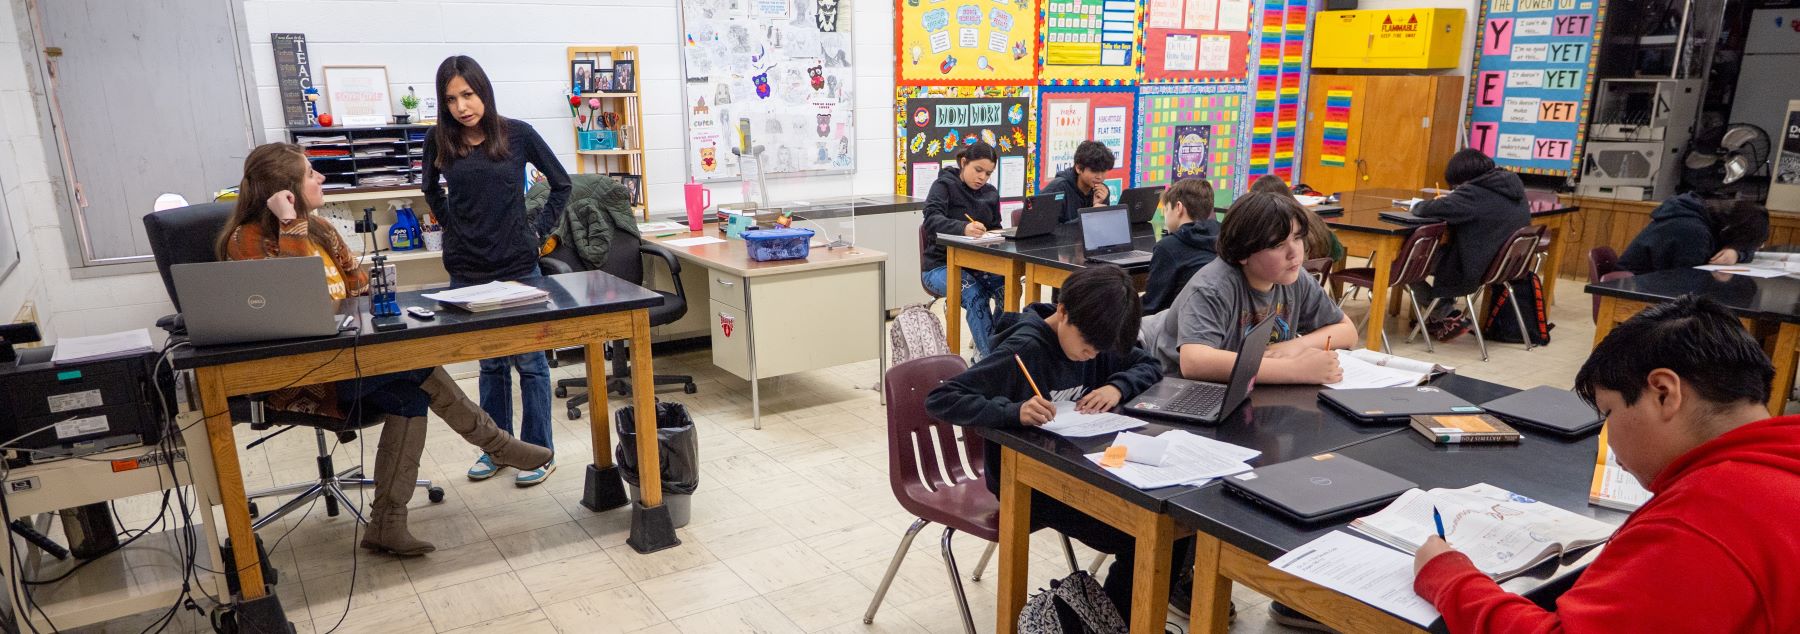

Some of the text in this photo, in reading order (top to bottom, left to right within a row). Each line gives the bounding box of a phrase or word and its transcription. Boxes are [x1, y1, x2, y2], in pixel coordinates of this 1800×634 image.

[1493, 0, 1512, 11] THE
[1518, 0, 1552, 10] POWER
[1382, 24, 1417, 32] FLAMMABLE
[1556, 16, 1590, 34] YET
[1551, 44, 1584, 61] YET
[1546, 70, 1579, 88] YET
[937, 104, 1001, 126] WOW WORK
[1542, 102, 1575, 120] YET
[1056, 117, 1081, 126] TODAY
[1536, 140, 1569, 158] YET
